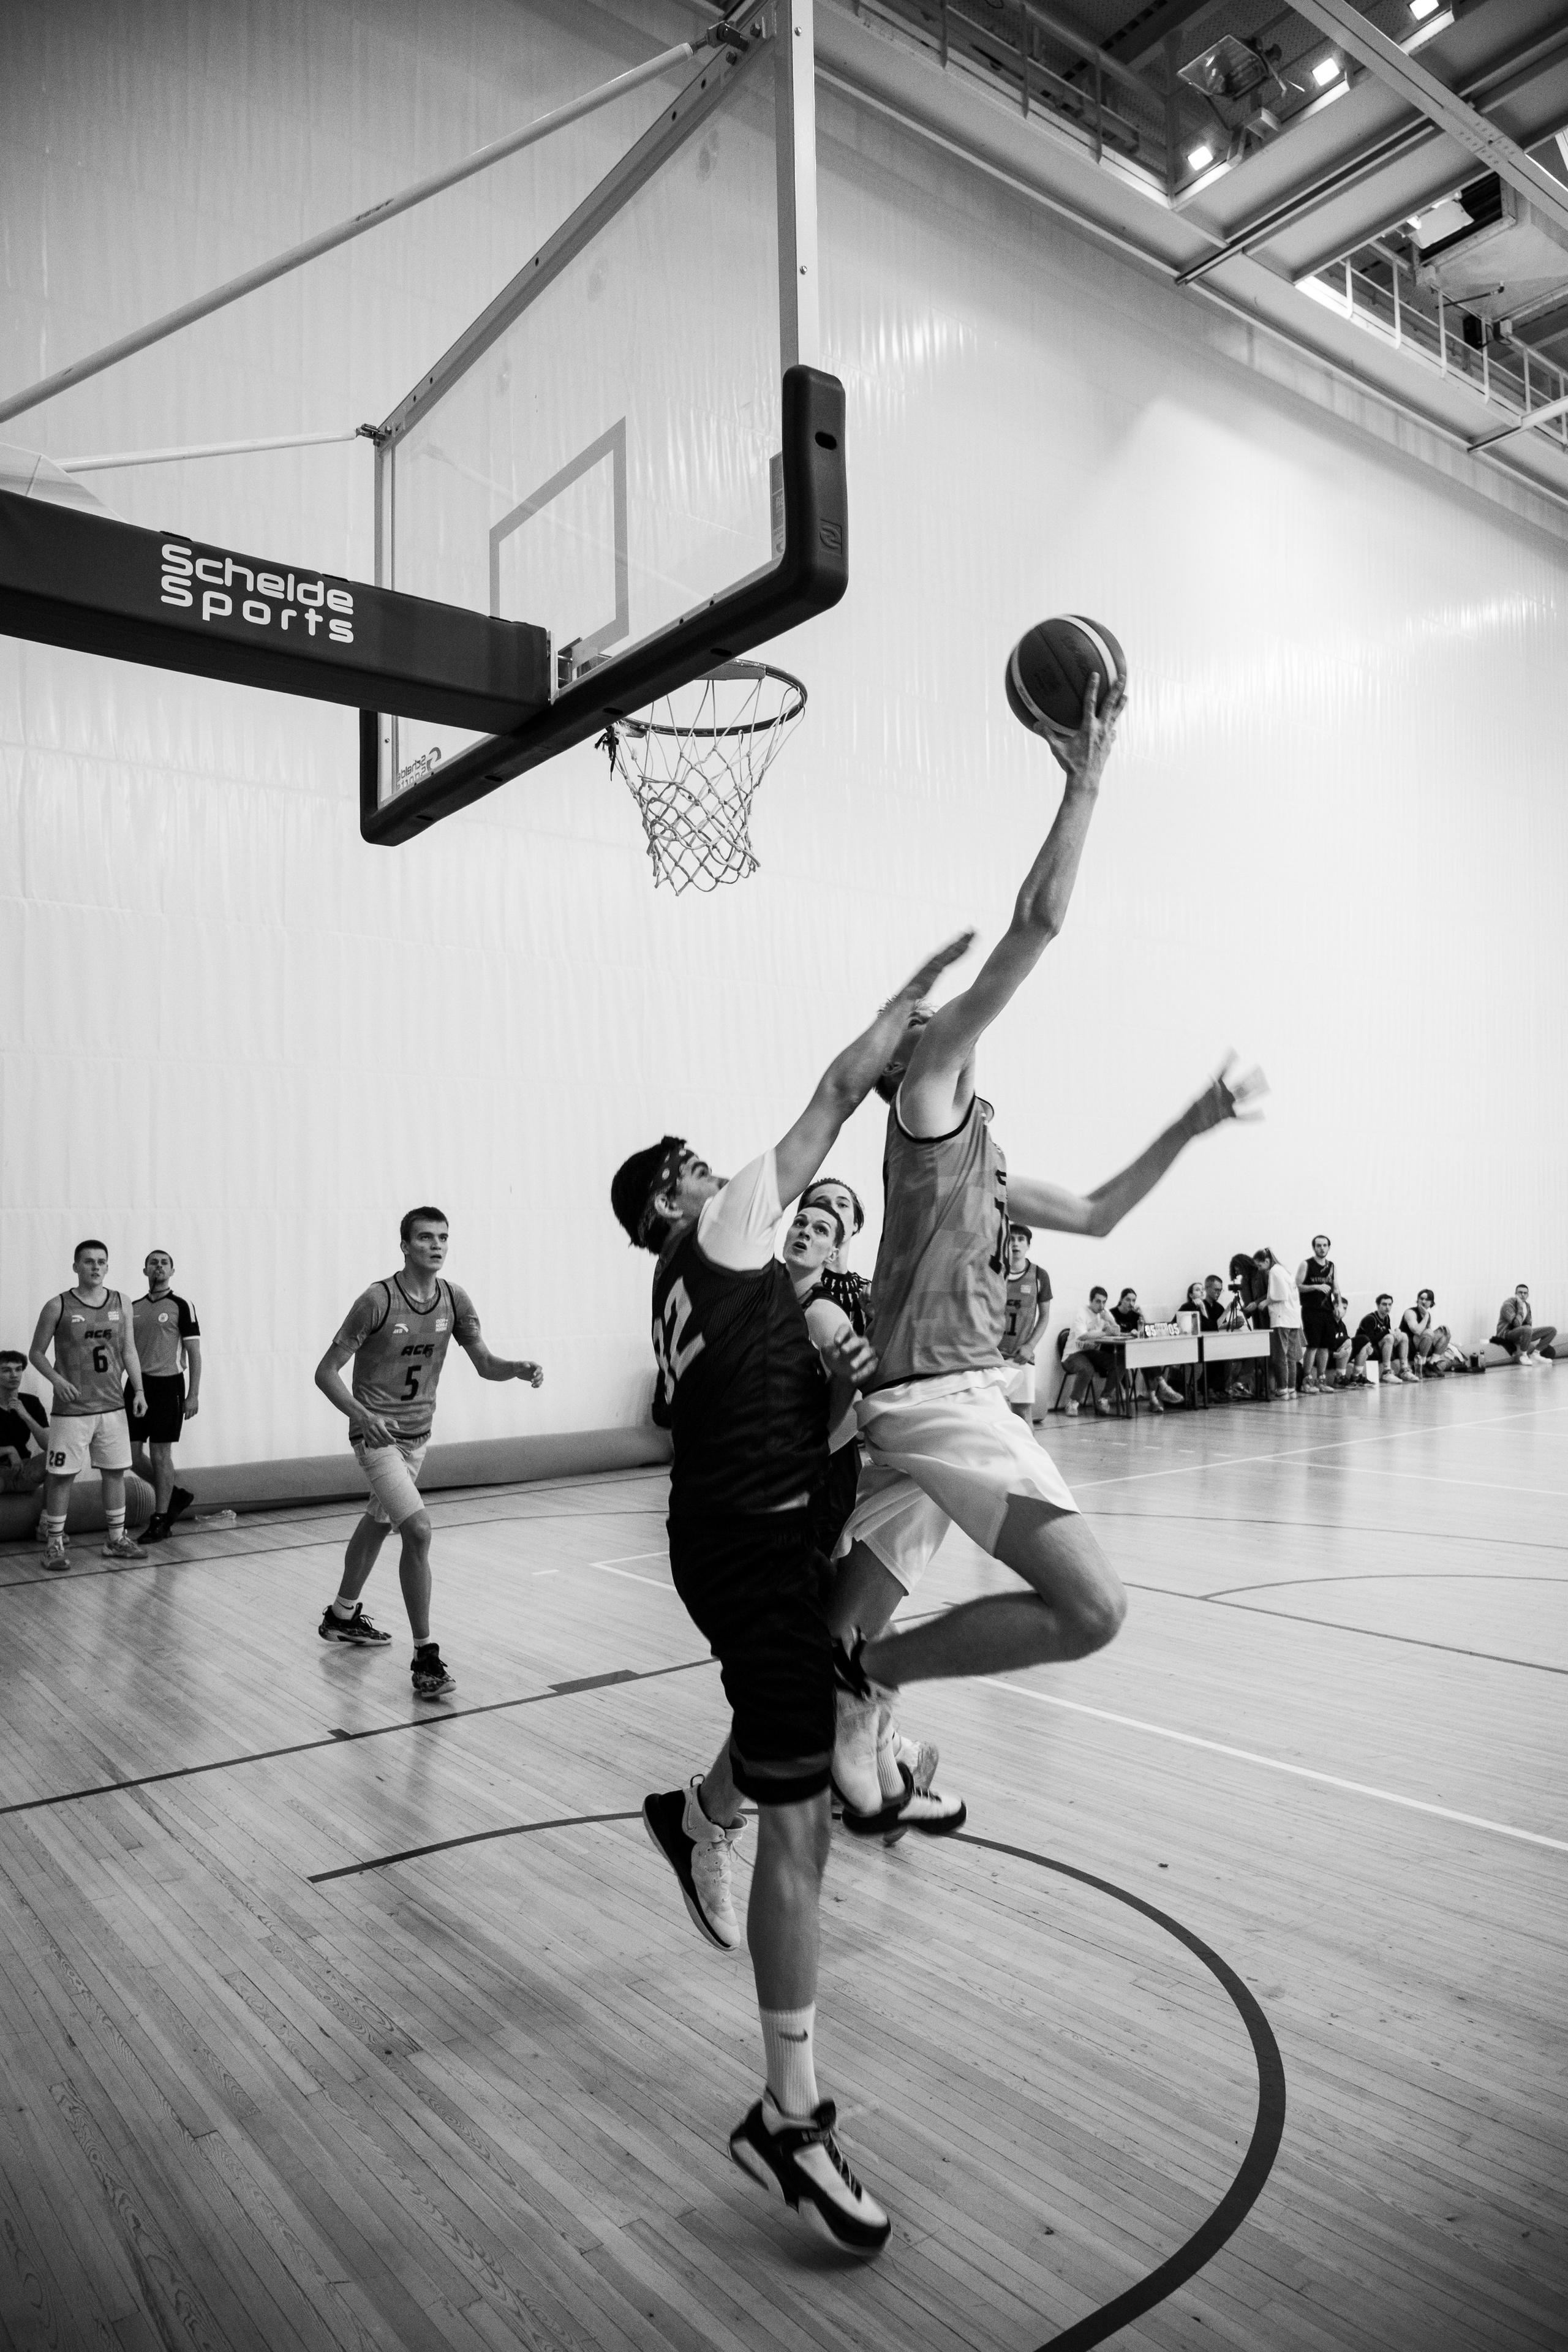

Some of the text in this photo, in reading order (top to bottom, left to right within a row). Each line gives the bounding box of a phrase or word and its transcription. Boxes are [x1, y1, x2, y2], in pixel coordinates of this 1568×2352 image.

[161, 543, 354, 615] Schelde
[160, 575, 354, 643] Sports
[1004, 1313, 1017, 1336] 1
[92, 1345, 108, 1373] 6
[400, 1365, 422, 1401] 5
[48, 1450, 66, 1467] 28
